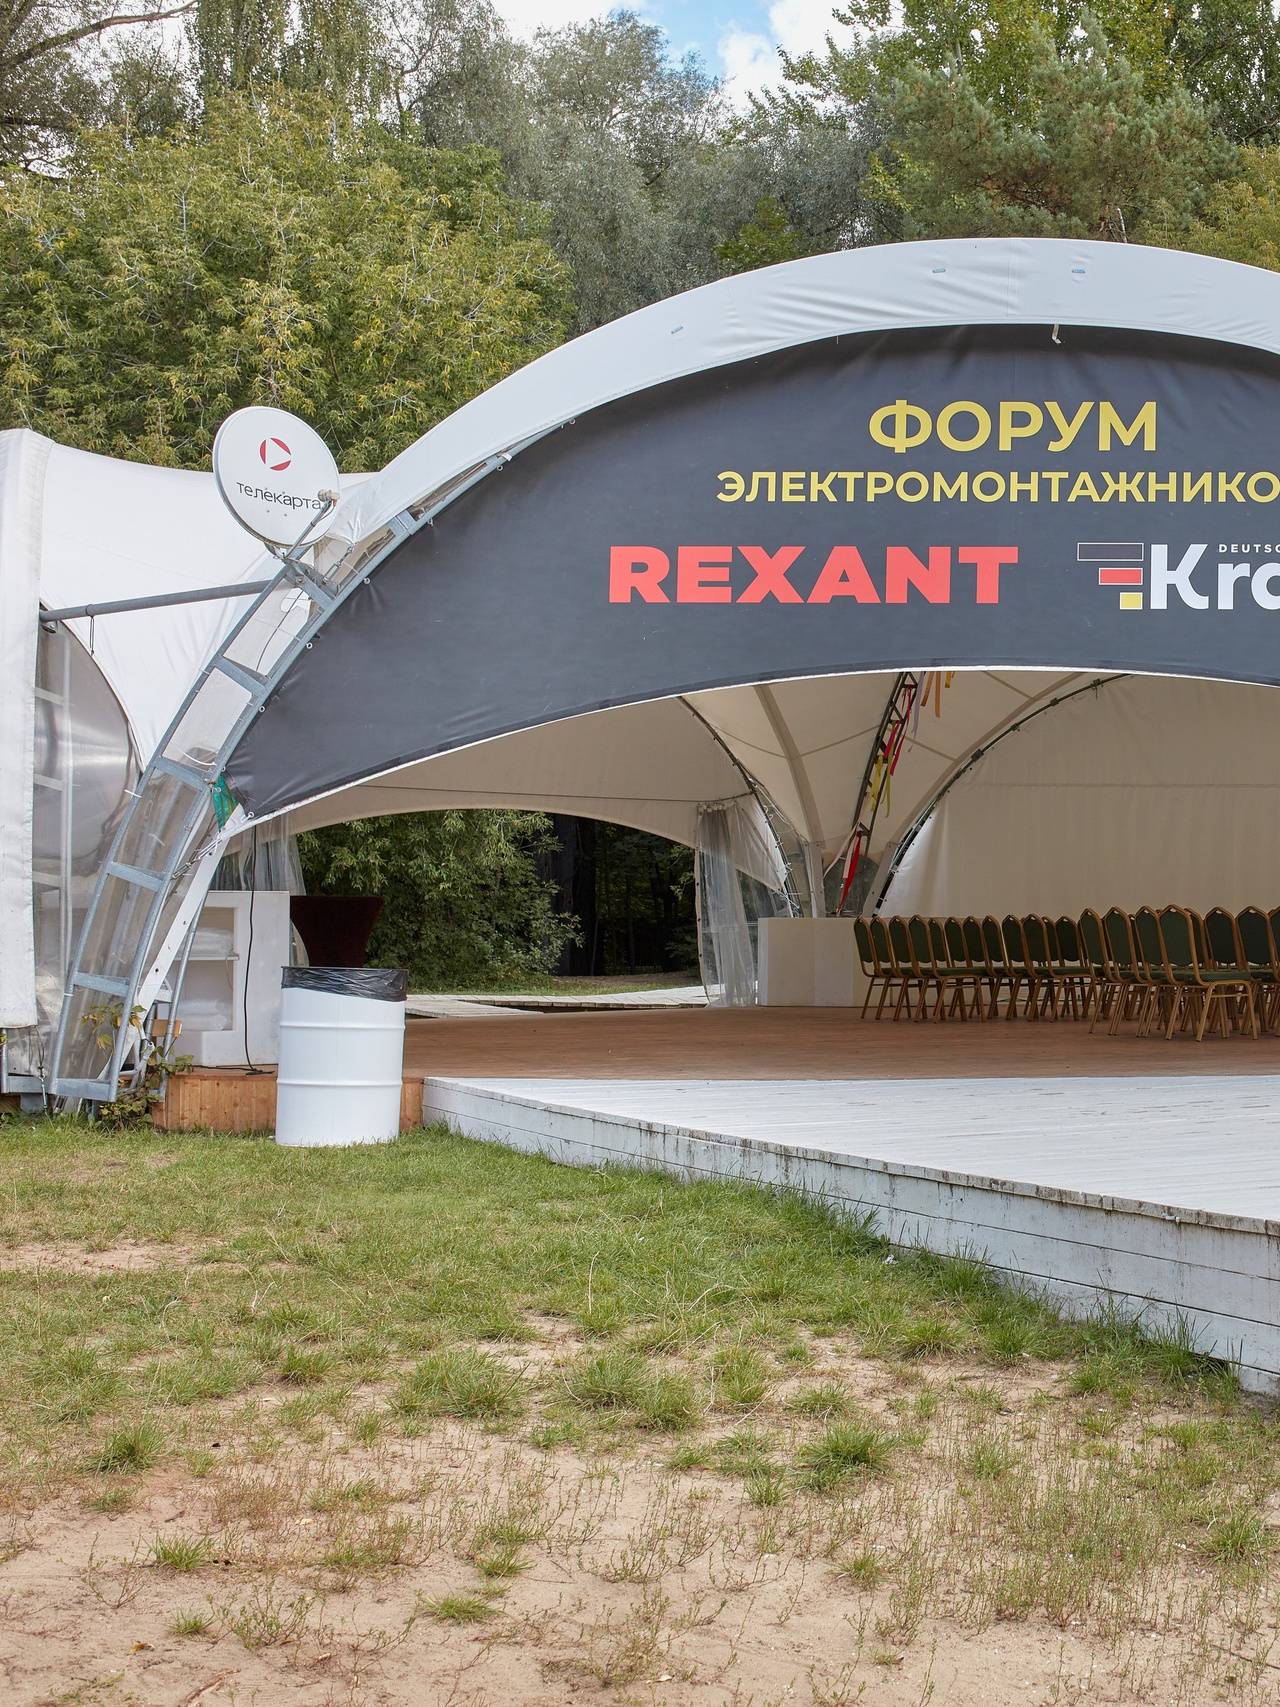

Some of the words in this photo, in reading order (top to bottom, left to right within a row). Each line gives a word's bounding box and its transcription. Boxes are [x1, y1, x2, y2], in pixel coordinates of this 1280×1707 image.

[868, 399, 1158, 454] ФОРУМ
[236, 481, 321, 510] телекарта
[609, 545, 1020, 605] REXANT
